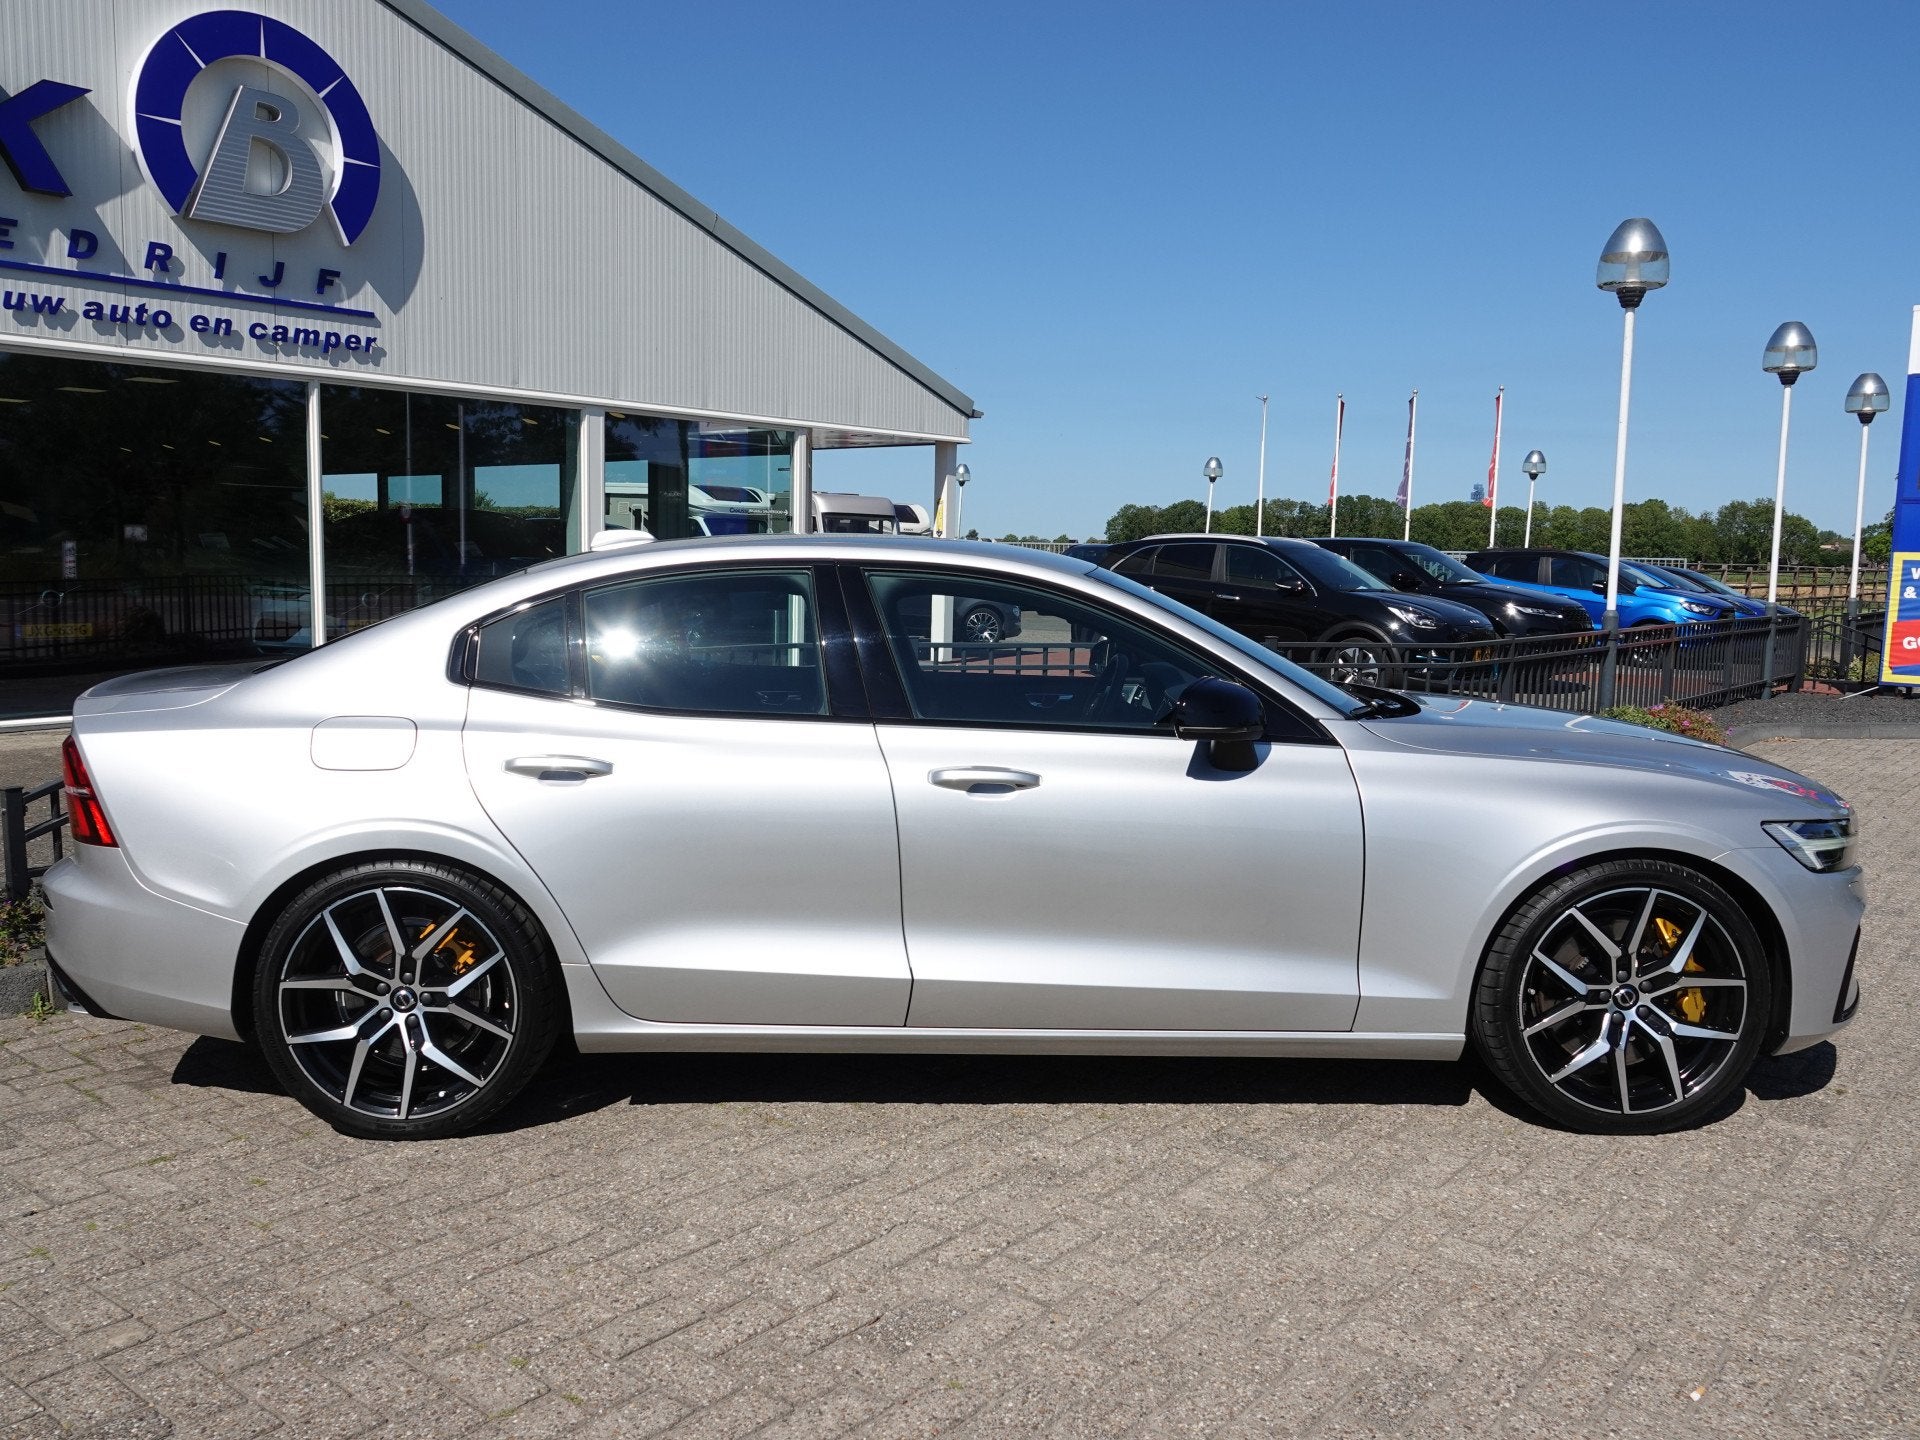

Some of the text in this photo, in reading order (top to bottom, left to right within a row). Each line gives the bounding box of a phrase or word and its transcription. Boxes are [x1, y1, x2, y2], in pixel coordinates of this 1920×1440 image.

[3, 290, 377, 353] uw auto en camper
